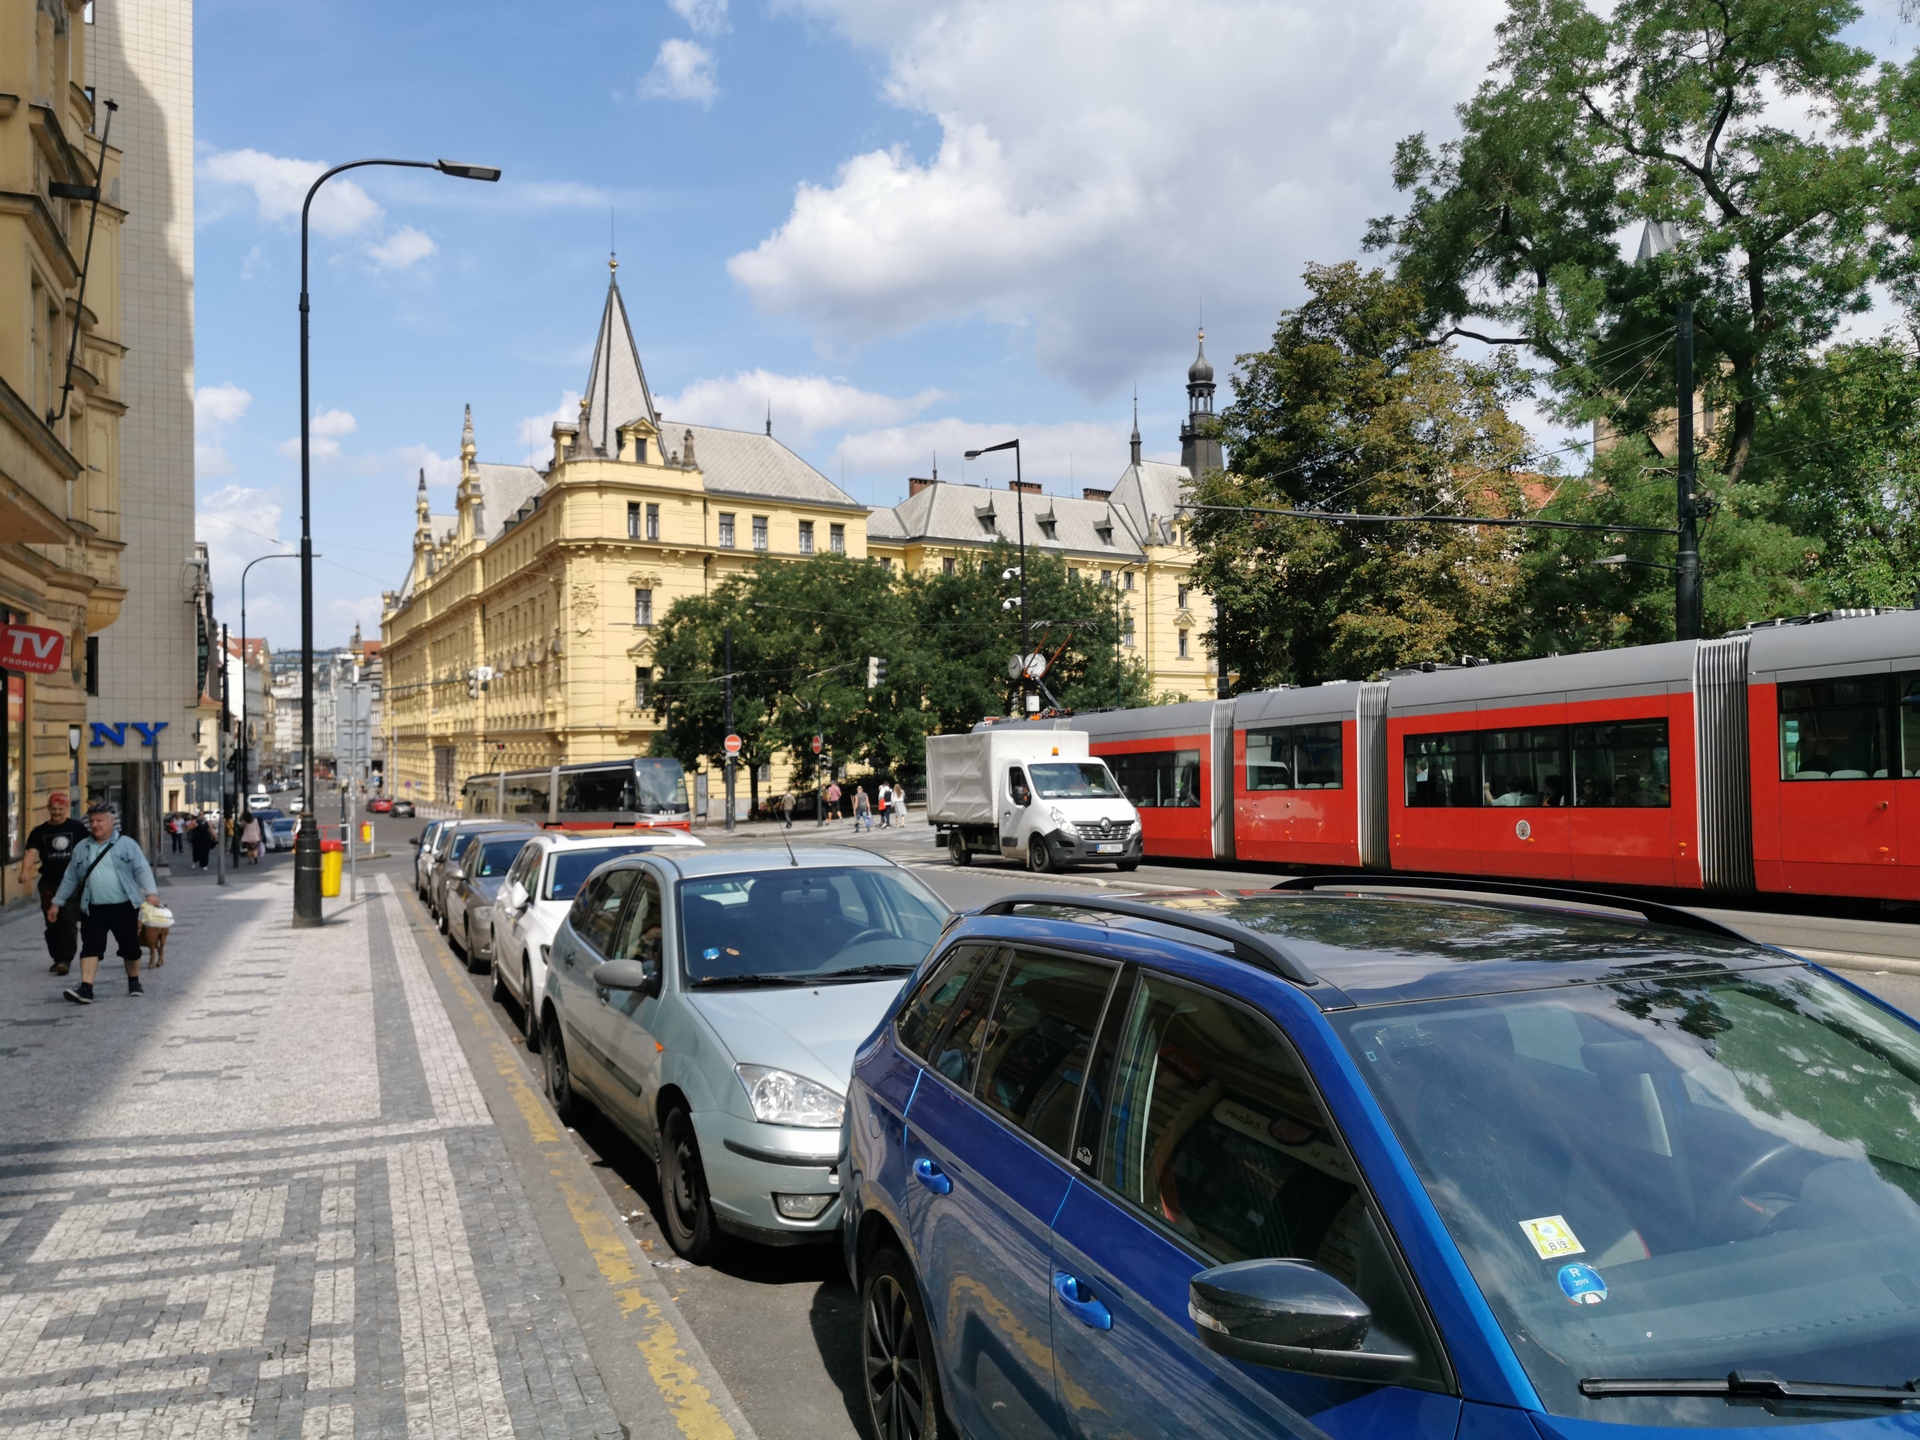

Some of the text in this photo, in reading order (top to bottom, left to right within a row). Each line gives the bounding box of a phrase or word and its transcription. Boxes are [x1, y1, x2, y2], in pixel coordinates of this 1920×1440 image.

[7, 629, 59, 659] TV
[2, 657, 54, 670] PRODUCTS
[1568, 1267, 1581, 1277] R
[1573, 1278, 1589, 1287] 2019
